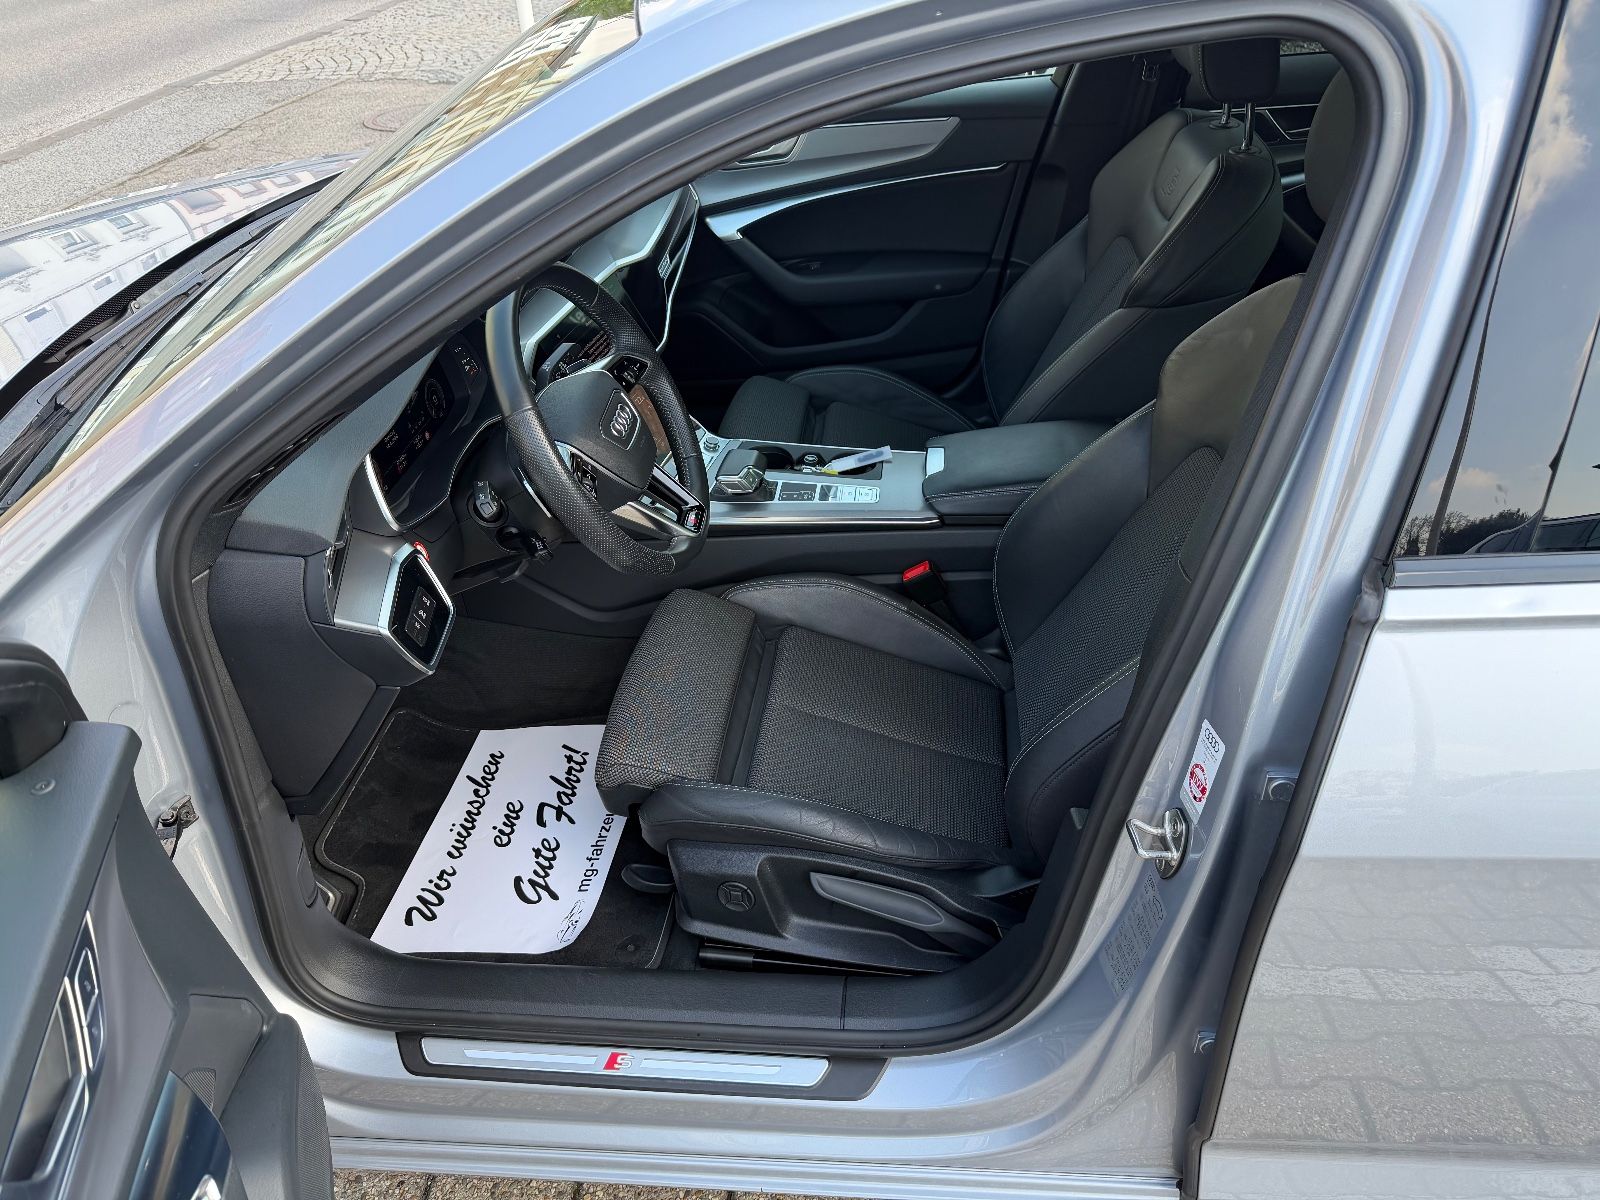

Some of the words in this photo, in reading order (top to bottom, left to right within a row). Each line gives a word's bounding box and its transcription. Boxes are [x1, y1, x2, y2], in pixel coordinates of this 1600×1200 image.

[493, 799, 524, 848] eine
[535, 743, 590, 829] Fahrt!
[404, 865, 458, 927] Wir
[446, 750, 505, 860] wünschen
[513, 836, 561, 905] Gute
